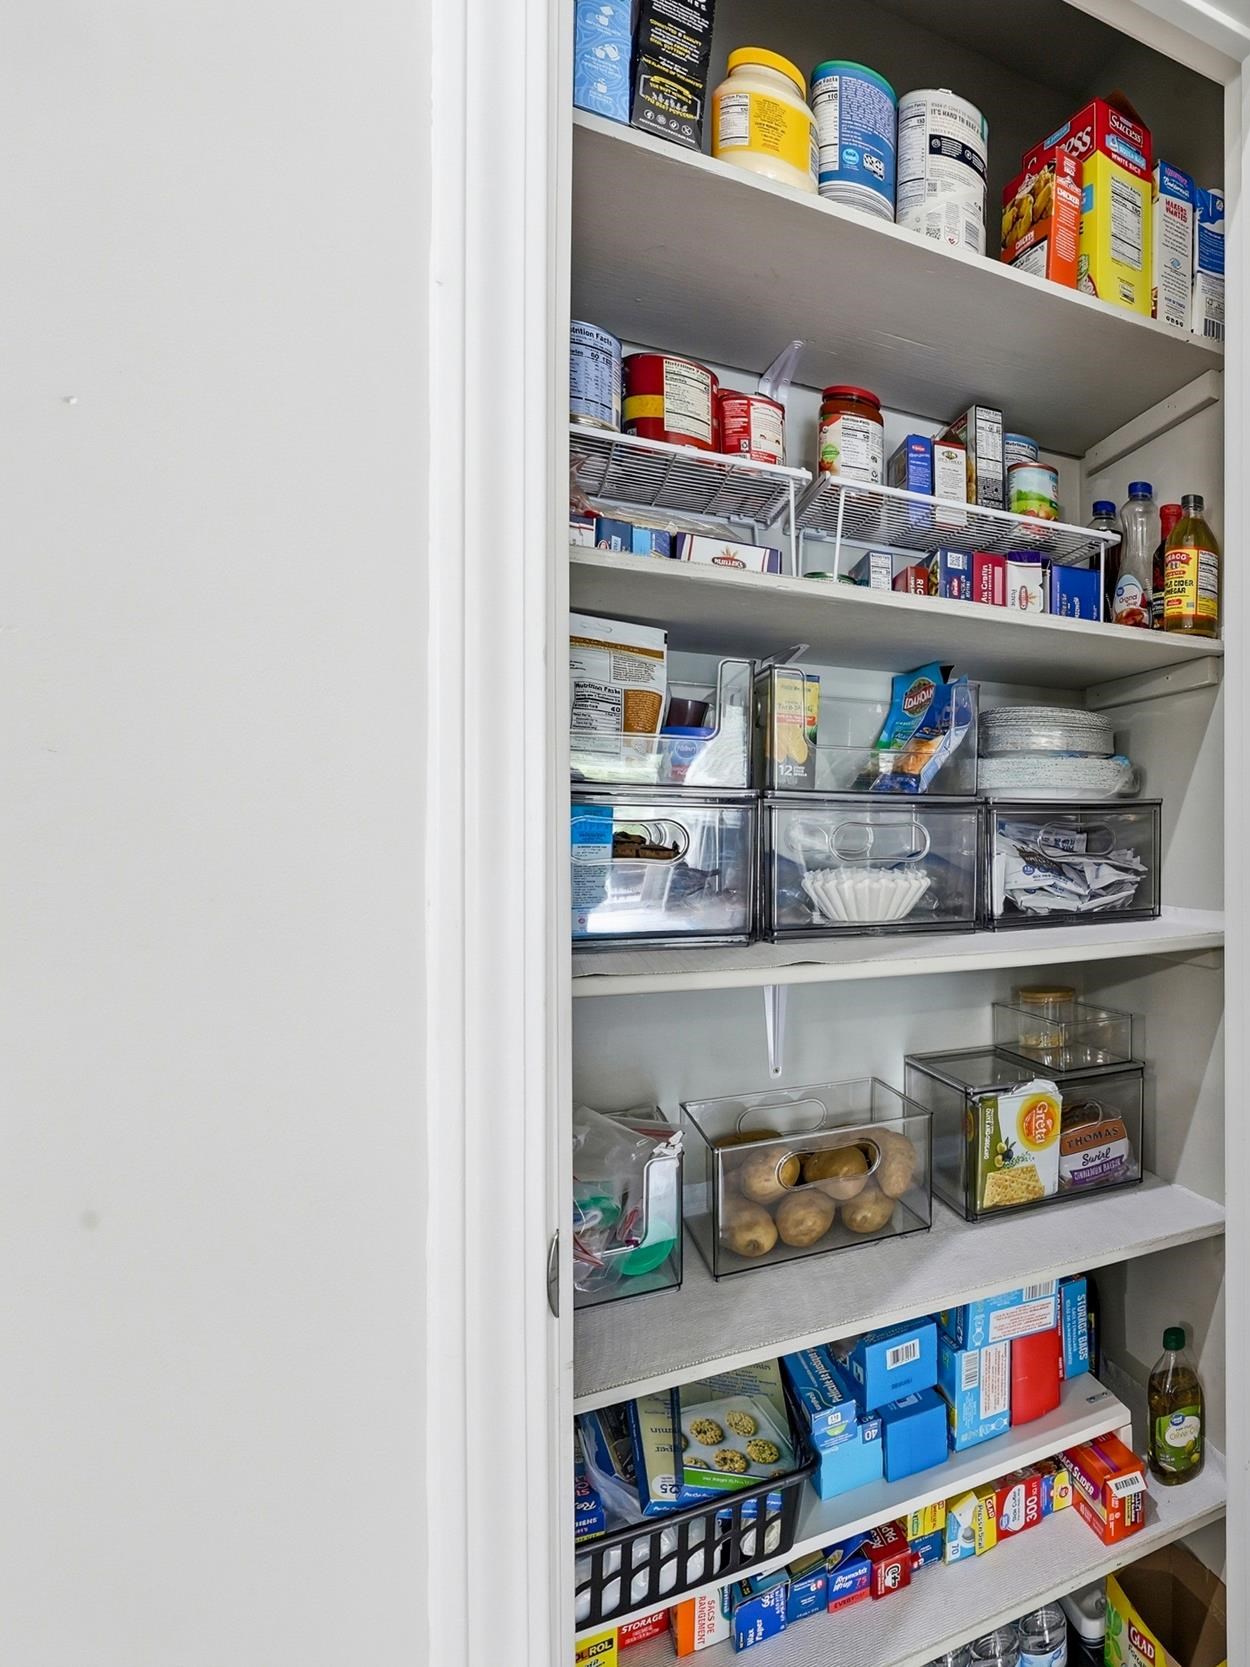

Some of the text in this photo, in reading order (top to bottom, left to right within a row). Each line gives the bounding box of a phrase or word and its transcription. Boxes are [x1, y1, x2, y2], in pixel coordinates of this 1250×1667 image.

[1111, 115, 1142, 144] Success
[595, 331, 612, 346] Facts
[916, 578, 924, 595] RIC
[1174, 580, 1194, 588] CIDER
[778, 764, 793, 776] 12
[1066, 1127, 1119, 1149] THOMAS
[1082, 1147, 1111, 1166] Swirl
[1077, 1294, 1089, 1361] STORAGE BAGS
[660, 1483, 682, 1494] 25
[1073, 1467, 1095, 1495] SLIDER
[985, 1497, 996, 1519] GLAD
[1026, 1495, 1038, 1523] 300
[621, 1613, 664, 1635] STORAGE
[698, 1596, 706, 1646] RANGEMENT
[707, 1600, 716, 1635] SACS DE
[1130, 1626, 1154, 1659] GLAD
